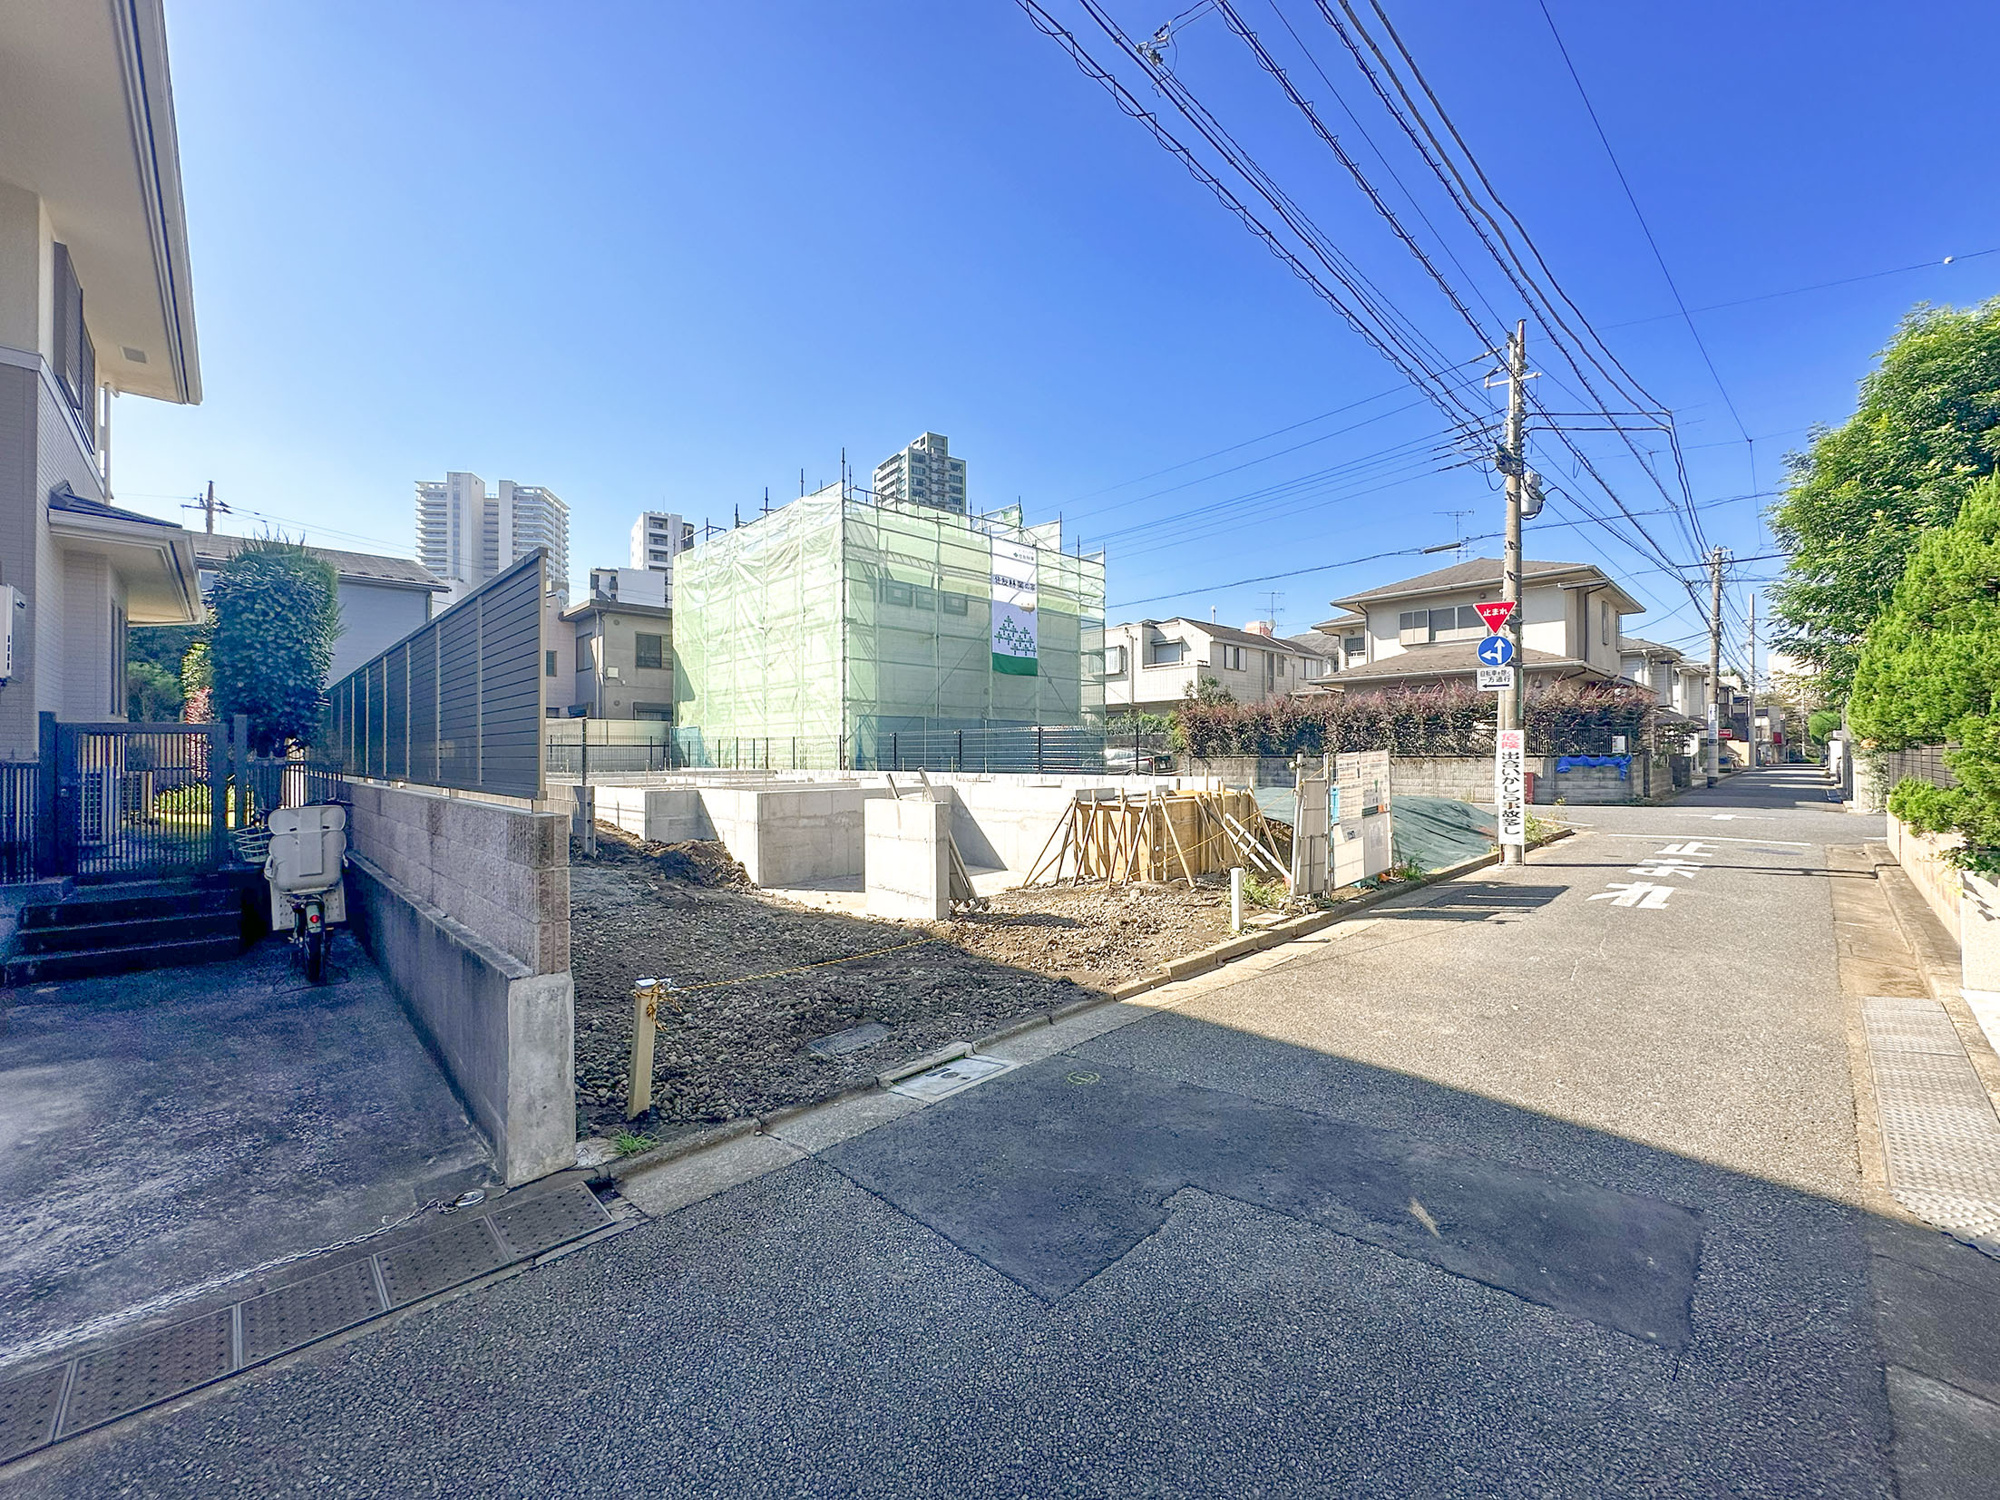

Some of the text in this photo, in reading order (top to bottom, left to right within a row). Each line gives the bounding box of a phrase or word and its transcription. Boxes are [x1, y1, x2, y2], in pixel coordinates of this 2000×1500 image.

[1483, 607, 1508, 617] 止まれ
[1480, 669, 1511, 678] 自転車を除く
[1502, 733, 1521, 749] 危険
[1585, 841, 1719, 909] 止まれ
